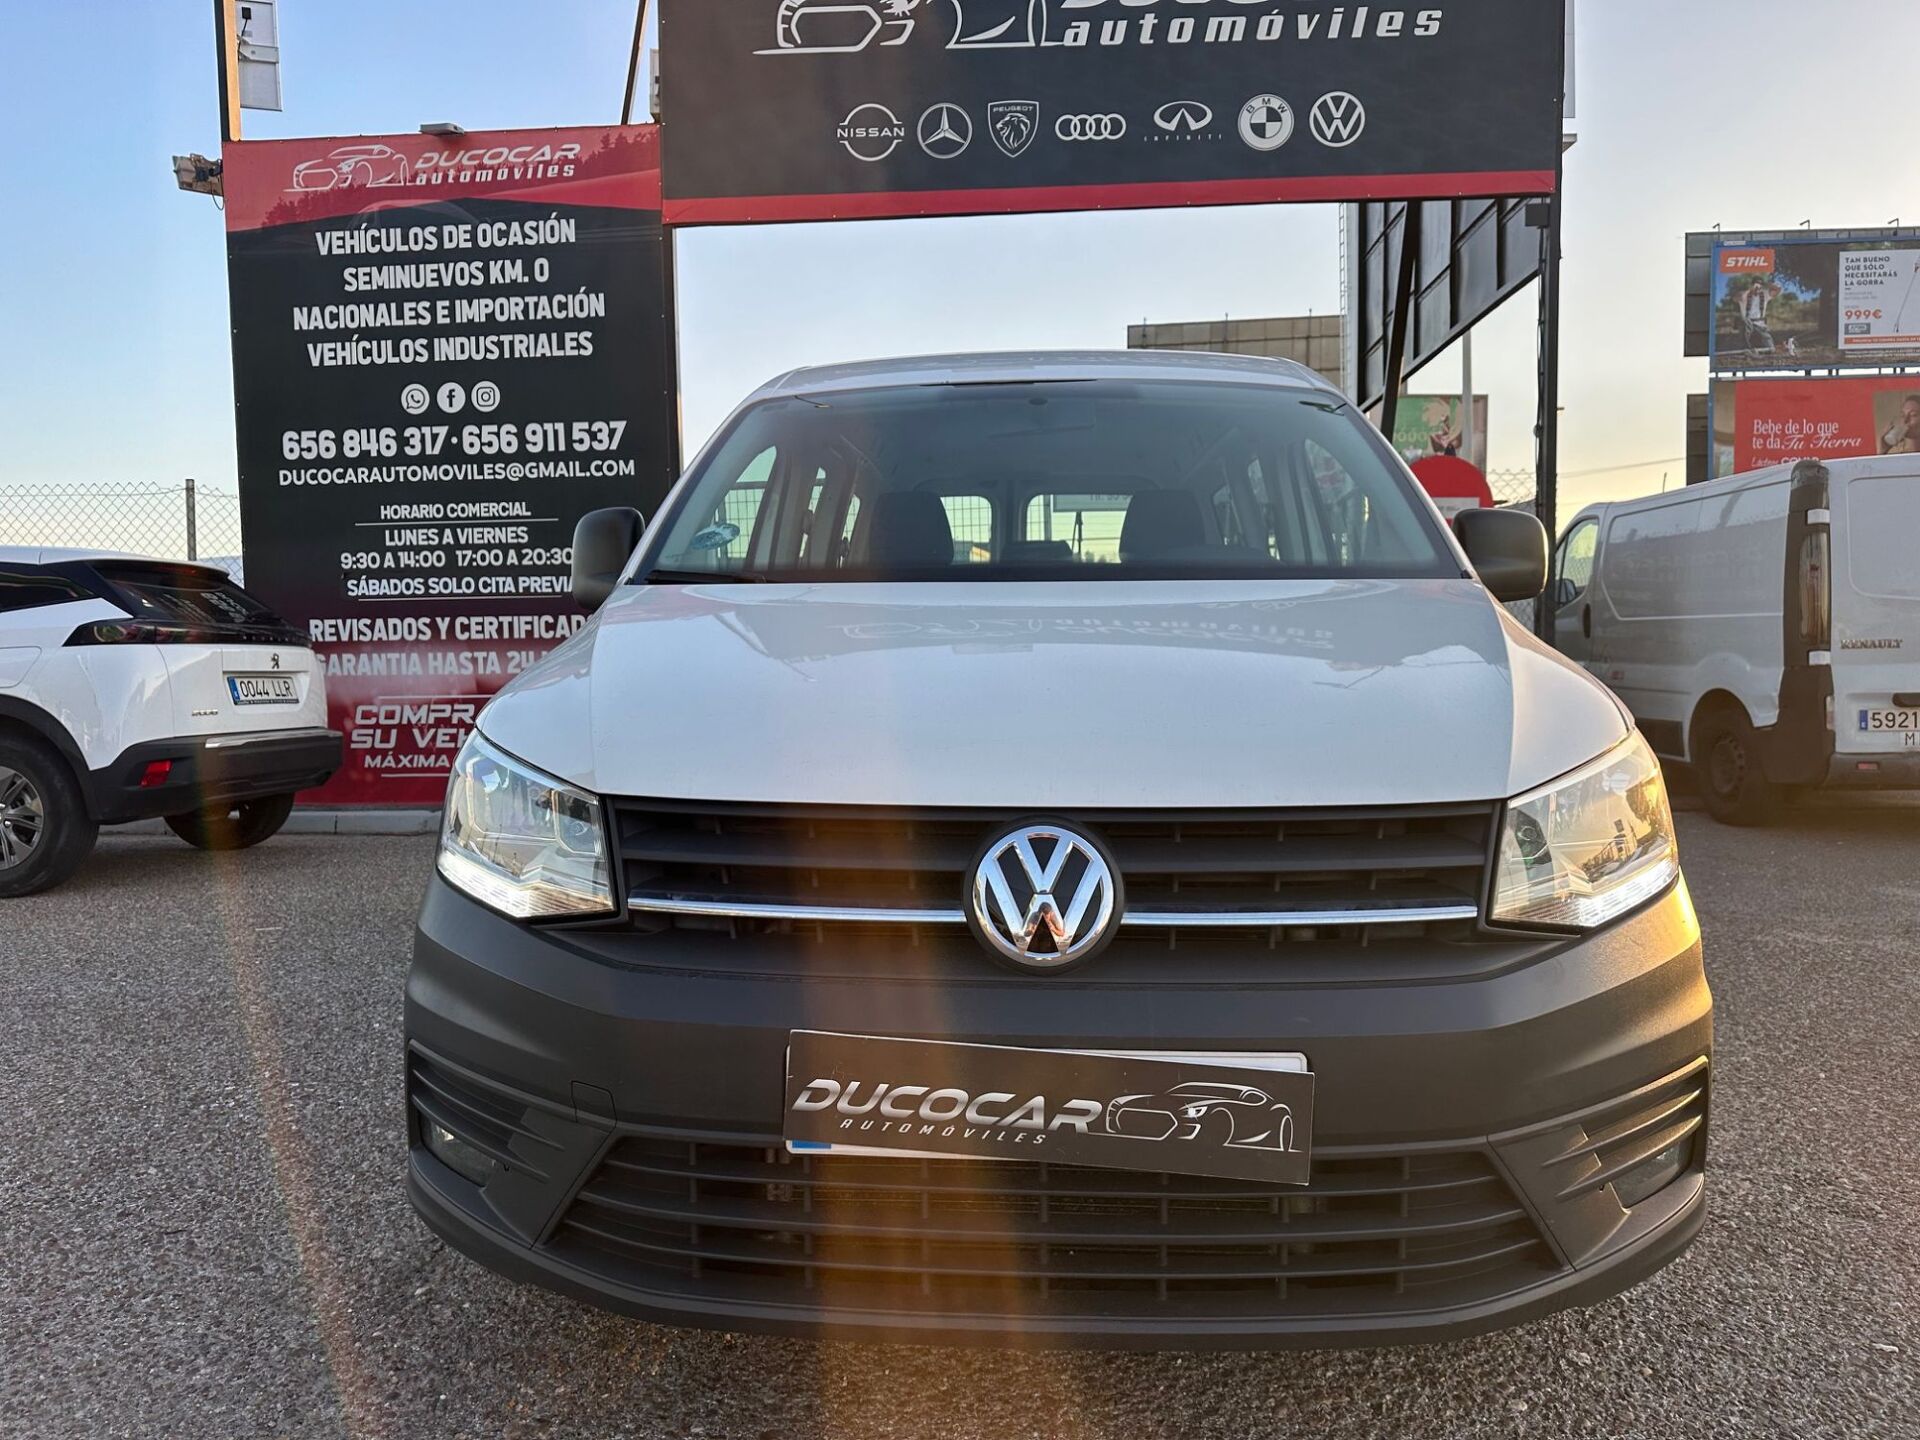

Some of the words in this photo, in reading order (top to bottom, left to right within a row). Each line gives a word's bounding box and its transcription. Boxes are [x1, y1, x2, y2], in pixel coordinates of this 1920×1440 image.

[1063, 6, 1443, 46] automóviles
[992, 105, 1034, 113] PEUGEOT
[1245, 97, 1288, 115] BMW
[837, 127, 905, 138] NISSAN
[415, 143, 581, 169] DUCOCAR
[315, 223, 438, 256] VEHÍCULOS
[442, 224, 472, 249] DE
[477, 212, 576, 246] OCASIÓN
[1726, 256, 1768, 267] STIHL
[343, 261, 485, 292] SEMINUEVOS
[489, 258, 529, 285] KM.
[1845, 270, 1897, 278] NECESITARÁS
[293, 301, 431, 330] NACIONALES
[436, 300, 450, 325] E
[455, 286, 605, 323] IMPORTACIÓN
[1845, 309, 1882, 319] 999€
[307, 334, 428, 367] VEHÍCULOS
[433, 331, 593, 362] INDUSTRIALES
[1753, 419, 1782, 434] Bebe
[1785, 419, 1799, 434] de
[1803, 419, 1814, 434] lo
[1817, 422, 1839, 436] que
[282, 429, 336, 460] 656
[342, 427, 397, 458] 846
[525, 422, 566, 453] 911
[572, 420, 627, 452] 537
[1752, 436, 1764, 449] te
[1766, 433, 1780, 449] da
[1781, 434, 1805, 449] Tu
[1810, 434, 1862, 449] Tierra
[279, 459, 635, 486] DUCOCARAUTOMOVILES@GMAIL.COM
[380, 503, 444, 520] HORARIO
[446, 502, 531, 517] COMERCIAL
[385, 528, 439, 546] LUNES
[442, 528, 454, 544] A
[457, 526, 529, 544] VIERNES
[340, 552, 380, 569] 9:30
[384, 552, 395, 568] A
[399, 550, 445, 568] 14:00
[456, 548, 504, 567] 17:00
[507, 549, 518, 566] A
[521, 548, 573, 565] 20:30
[347, 575, 424, 596] SÁBADOS
[428, 576, 475, 594] SOLO
[478, 576, 516, 593] CITA
[309, 616, 431, 642] REVISADOS
[436, 616, 450, 640] Y
[455, 614, 594, 641] CERTIFICAD
[1840, 639, 1903, 650] RENAULT
[428, 651, 502, 676] HASTA
[240, 680, 269, 697] 0044
[272, 680, 293, 697] LLR
[1871, 711, 1918, 728] 5921
[350, 729, 397, 749] SU
[364, 751, 450, 768] MÁXIMA
[791, 1078, 1103, 1134] DUCOCAR
[839, 1118, 1046, 1145] AUTOMÓVILES
